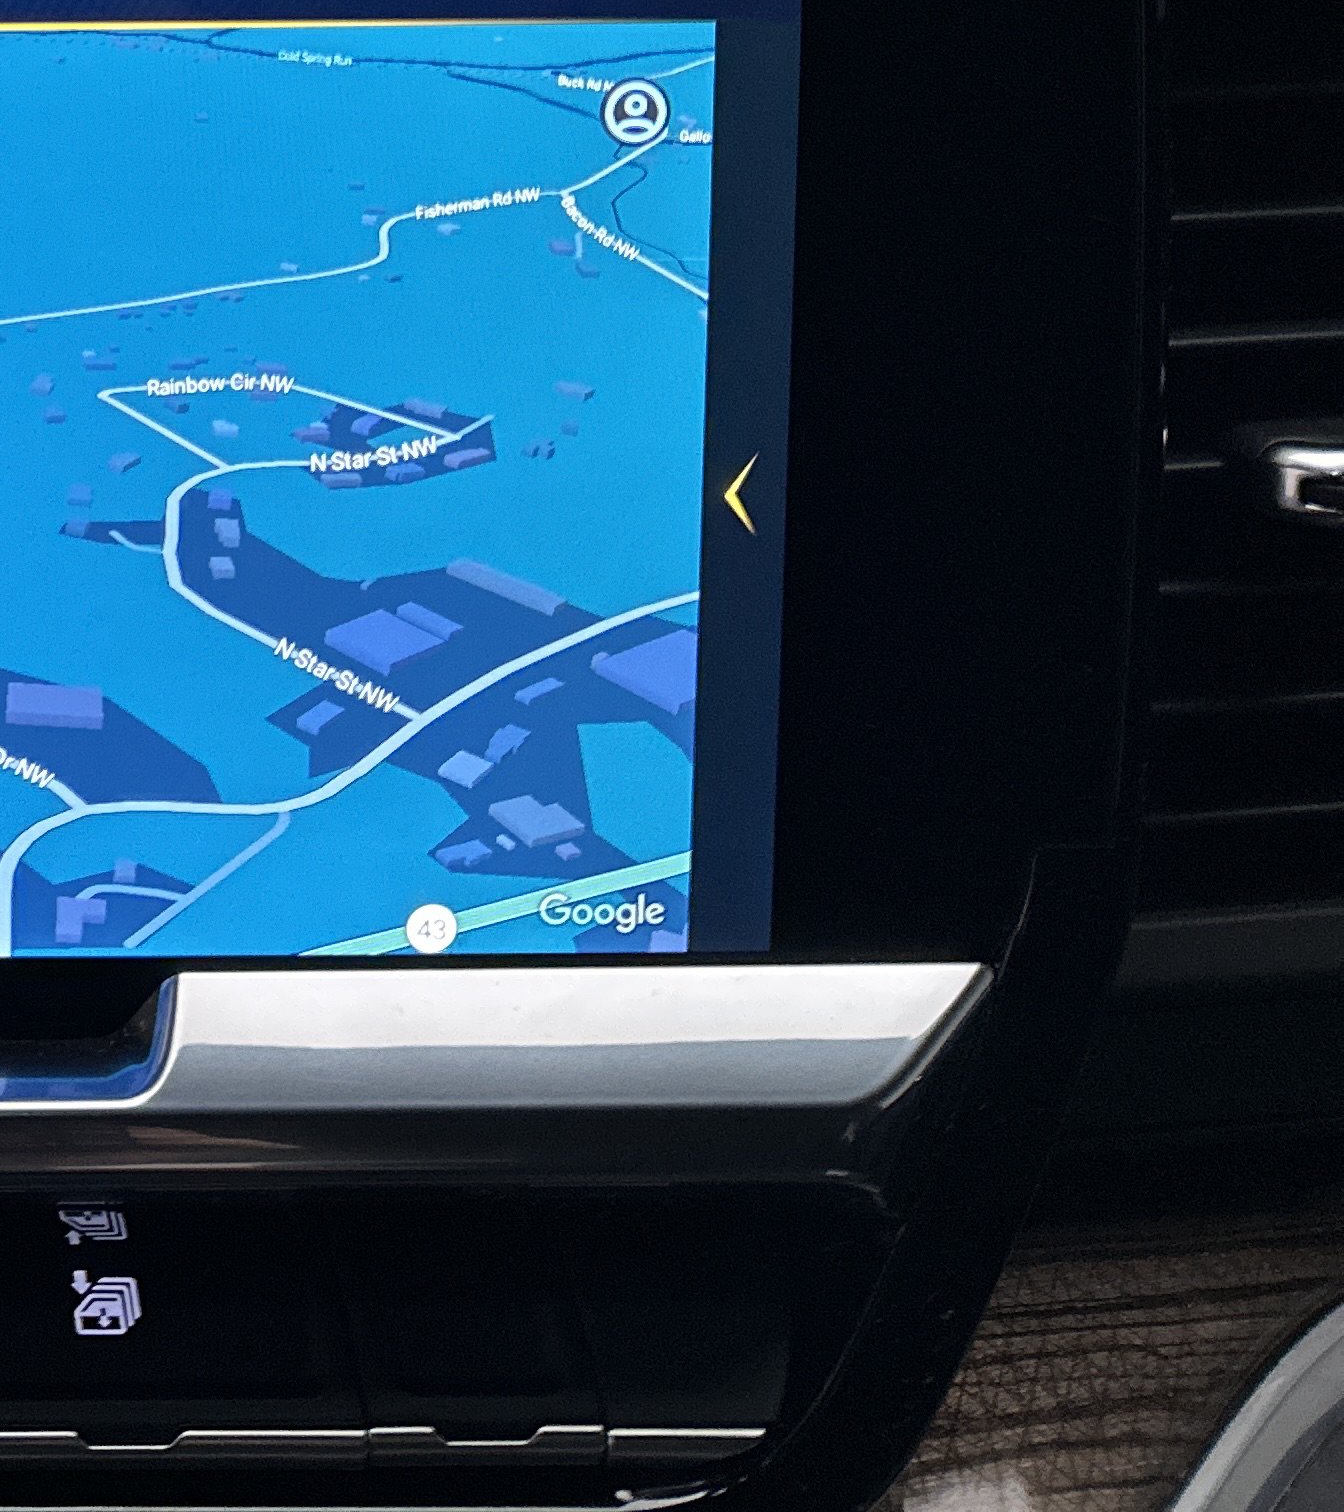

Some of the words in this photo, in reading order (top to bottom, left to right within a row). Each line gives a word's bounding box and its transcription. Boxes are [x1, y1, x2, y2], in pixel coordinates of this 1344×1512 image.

[301, 49, 332, 67] Spring
[332, 53, 353, 66] Run
[586, 76, 602, 92] Rd
[415, 193, 490, 220] Fisherman
[492, 190, 513, 207] Rd
[515, 186, 541, 203] NW
[561, 192, 596, 236] Bacon
[593, 225, 616, 247] Rd
[613, 239, 641, 262] NW
[146, 375, 226, 397] Rainbow
[230, 372, 257, 391] Cir
[260, 373, 295, 394] NW
[310, 453, 328, 472] N
[330, 451, 372, 471] Star
[375, 444, 398, 465] St
[402, 435, 438, 462] NW
[273, 637, 296, 660] N
[293, 647, 340, 682] Star
[334, 669, 363, 695] St
[358, 680, 401, 713] NW
[14, 757, 56, 789] NW
[417, 919, 447, 939] 43
[539, 892, 666, 934] Google
